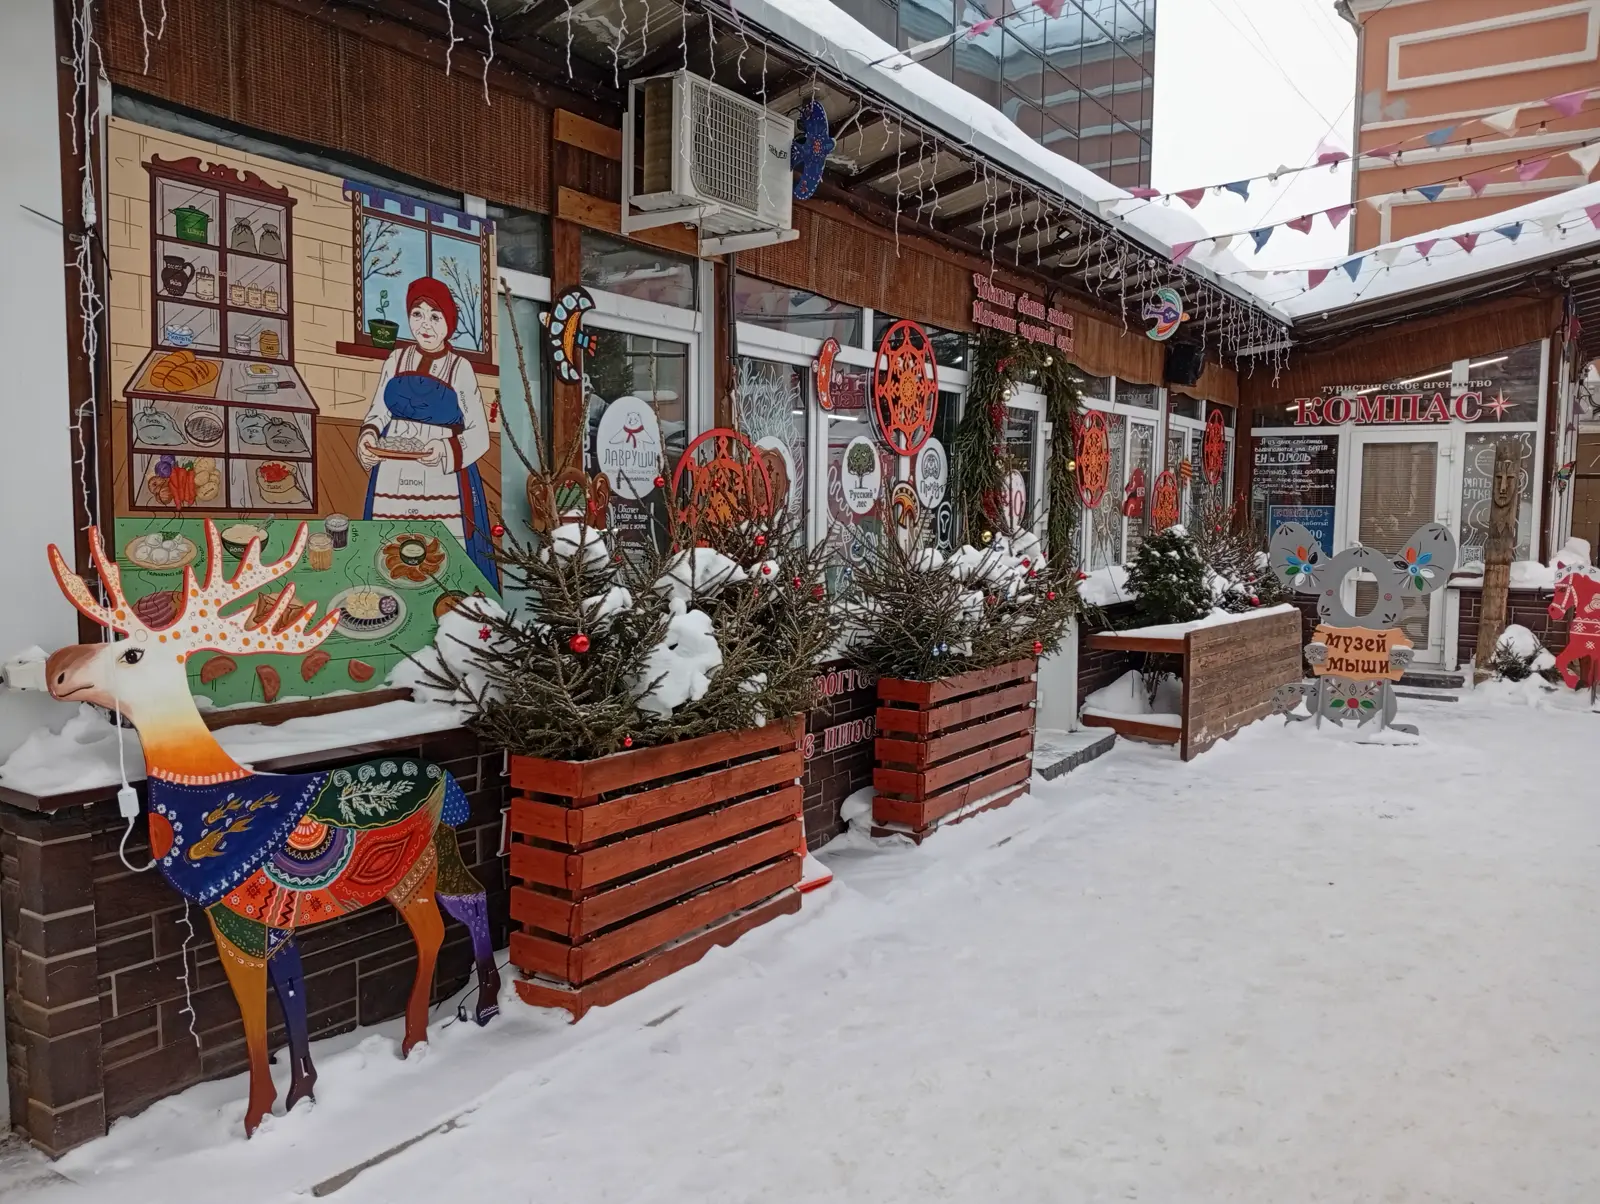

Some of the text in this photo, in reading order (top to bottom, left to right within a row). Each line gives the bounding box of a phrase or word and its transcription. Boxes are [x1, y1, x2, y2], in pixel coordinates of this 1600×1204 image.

[972, 299, 1017, 335] Магазин
[1321, 379, 1493, 395] туристическое агентство
[1294, 391, 1484, 426] КОМПАС
[1463, 477, 1492, 488] МАТЬ
[849, 488, 874, 499] Русский
[1463, 488, 1491, 499] УТКА
[856, 500, 868, 508] лес
